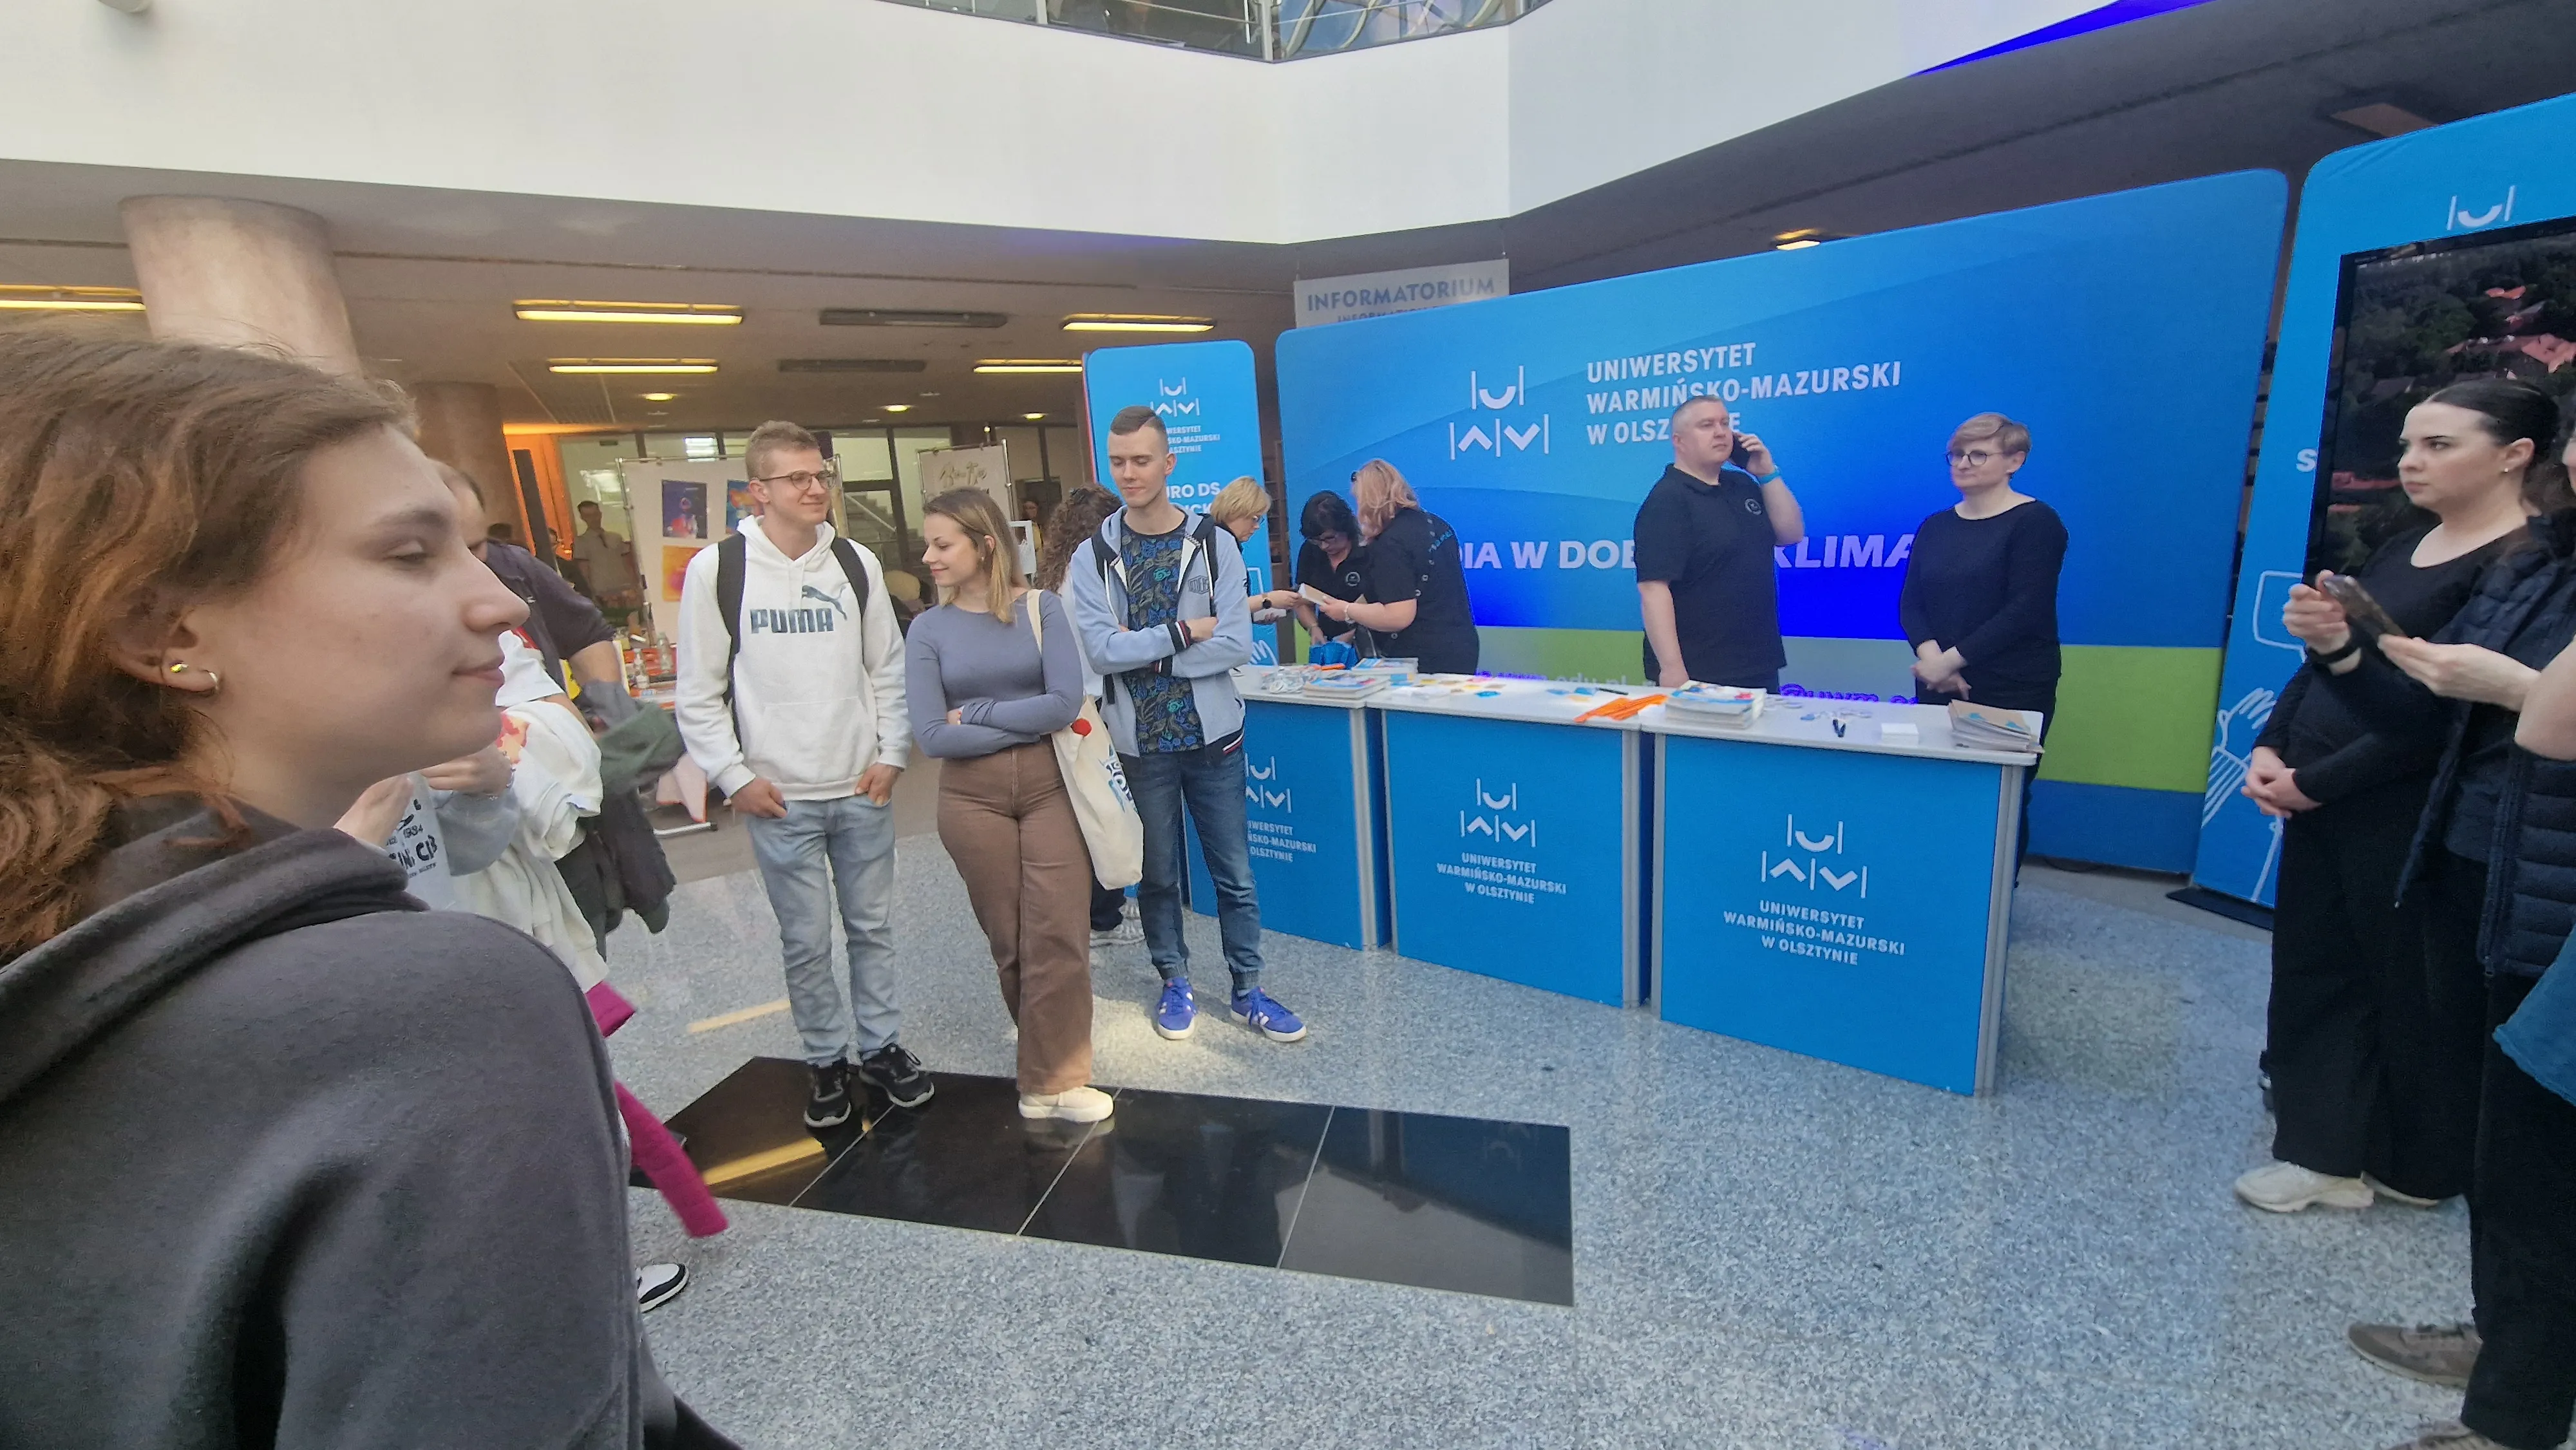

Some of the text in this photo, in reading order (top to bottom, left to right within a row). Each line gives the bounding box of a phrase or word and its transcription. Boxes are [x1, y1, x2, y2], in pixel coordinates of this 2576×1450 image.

[1308, 278, 1495, 311] INFORMATORIUM
[1587, 342, 1756, 383] UNIWERSYTET
[1587, 361, 1901, 415] WARMIŃSKO-MAZURSKI
[1587, 424, 1607, 445] W
[1510, 541, 1549, 569] W
[750, 608, 834, 634] PUMA
[1250, 845, 1293, 862] OLSZTYNIE
[1461, 852, 1537, 874] UNIWERSYTET
[1437, 863, 1567, 894] WARMIŃSKO-MAZURSKI
[1464, 882, 1535, 904] W OLSZTYNIE
[1759, 900, 1865, 929] UNIWERSYTET
[1723, 911, 1905, 956] WARMIŃSKO-MAZURSKI
[1761, 935, 1859, 965] W OLSZTYNIE
